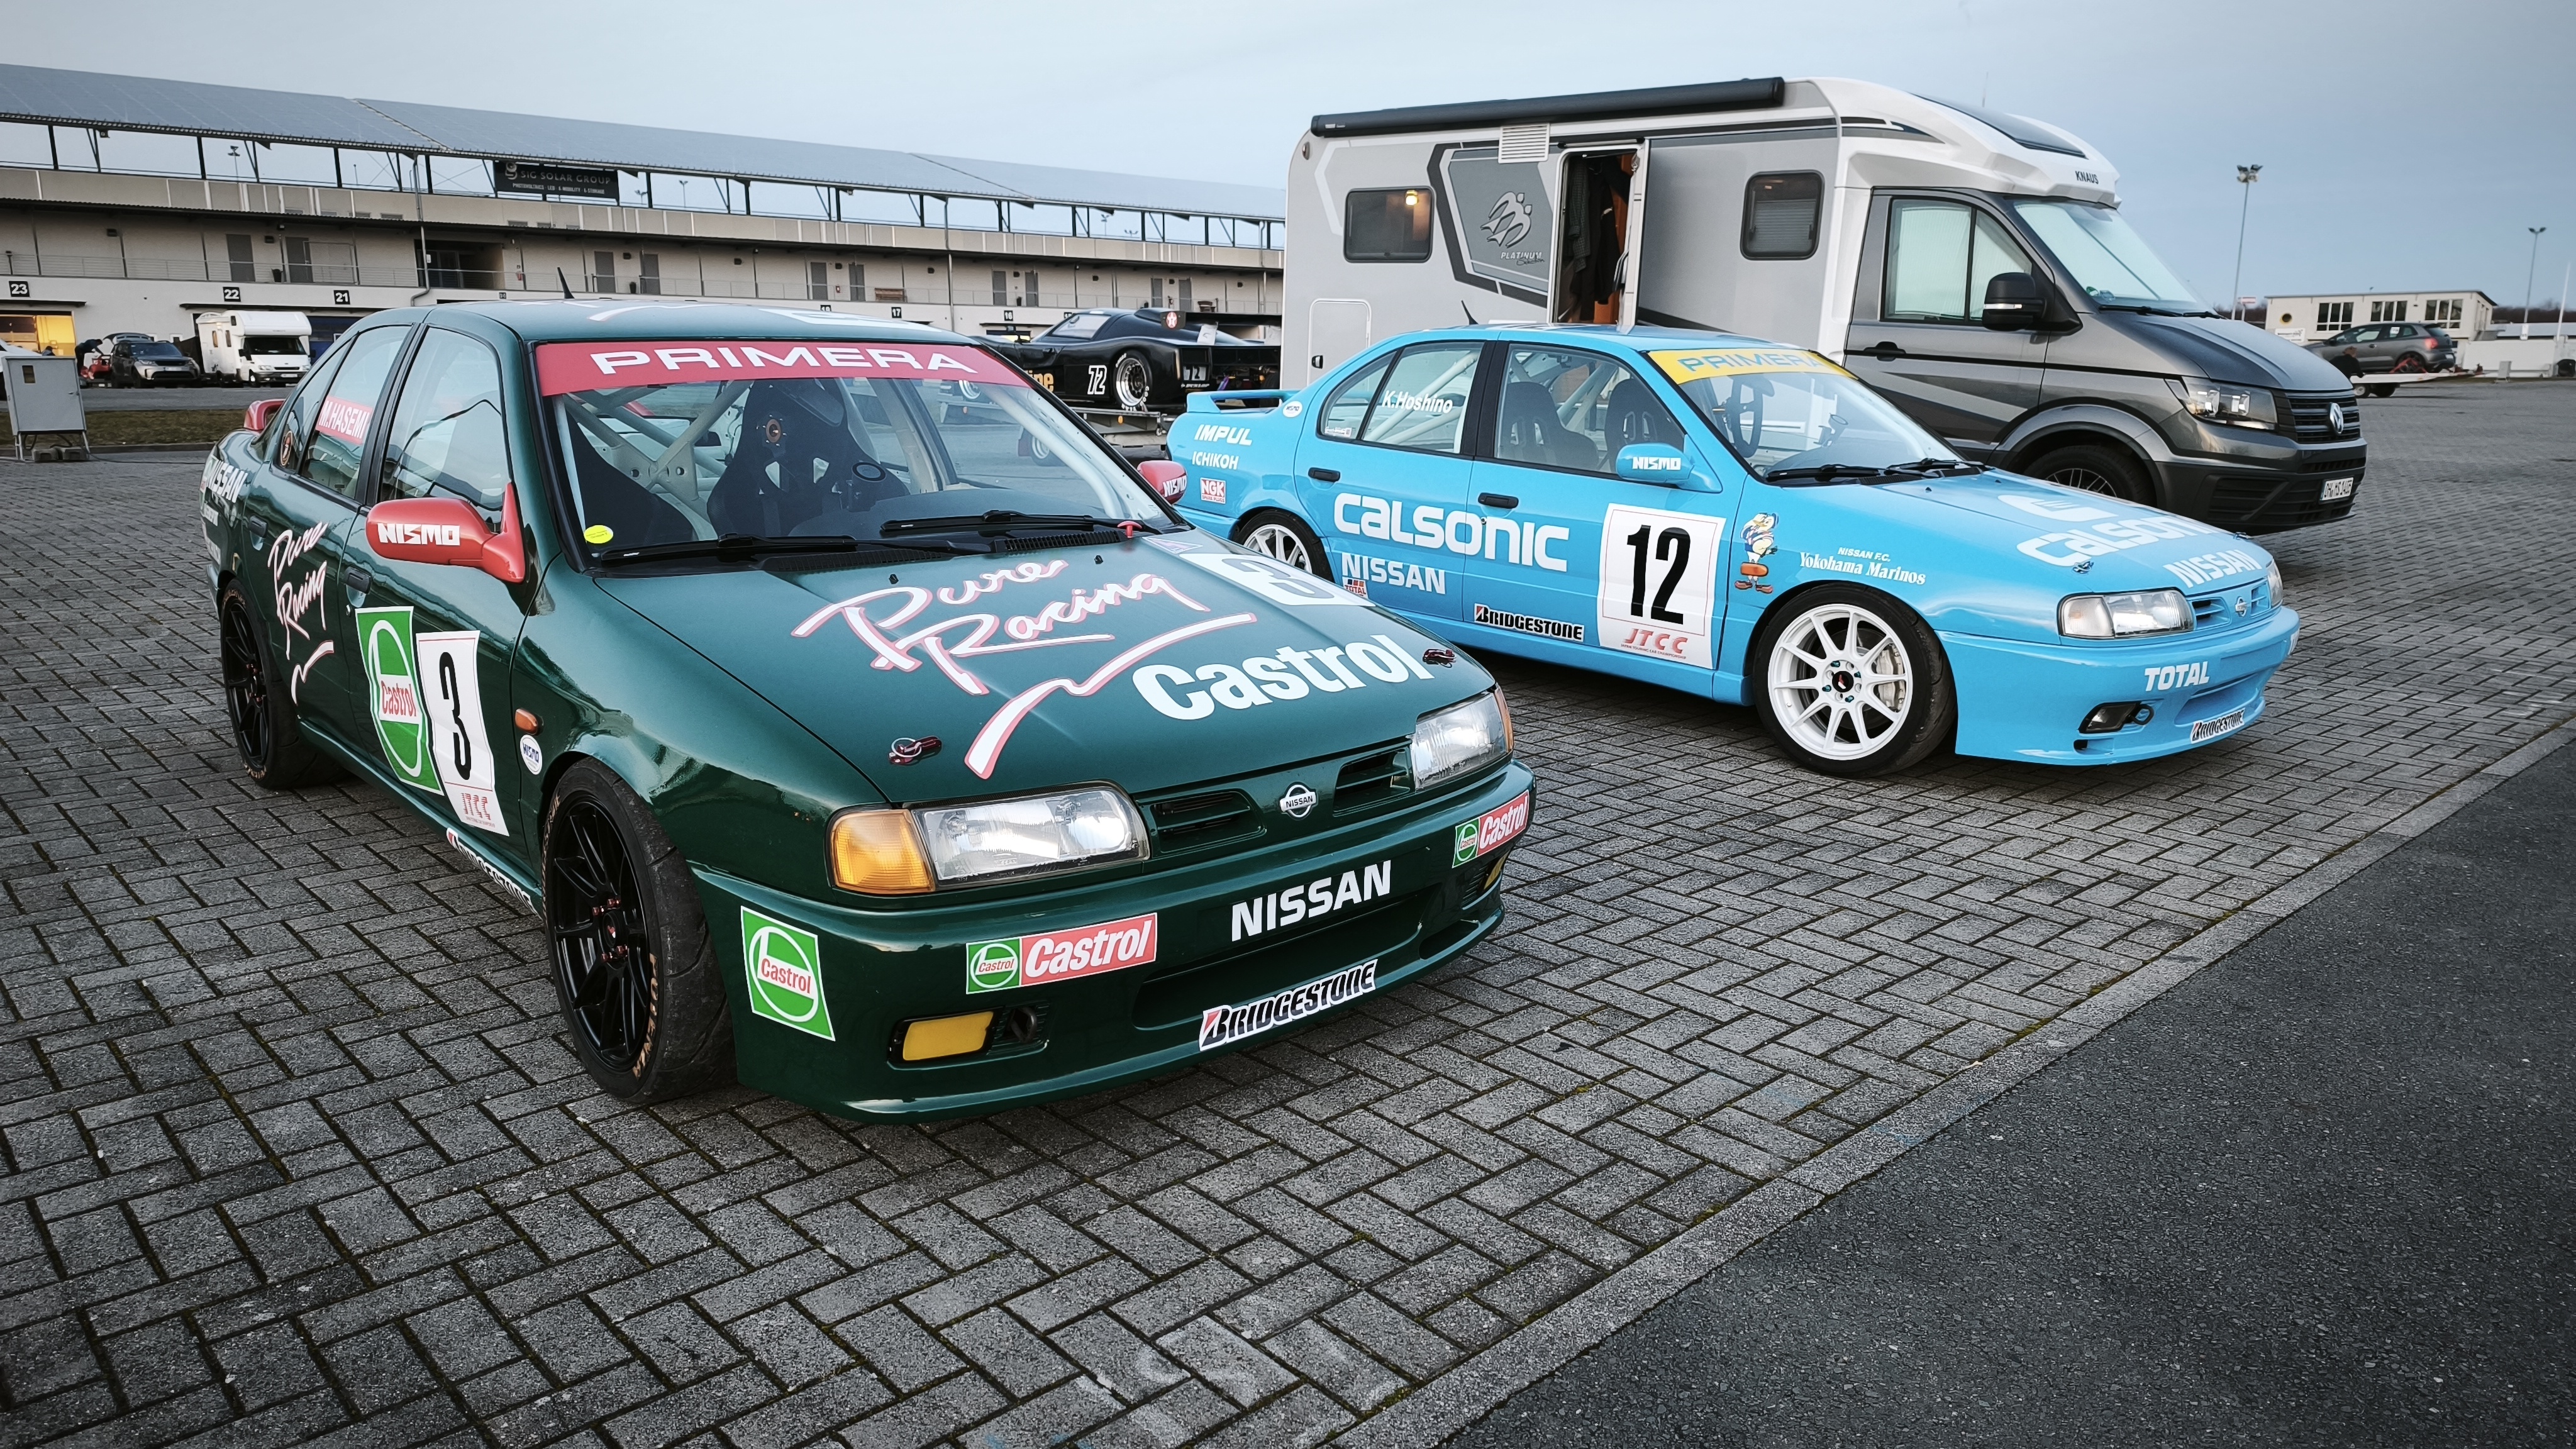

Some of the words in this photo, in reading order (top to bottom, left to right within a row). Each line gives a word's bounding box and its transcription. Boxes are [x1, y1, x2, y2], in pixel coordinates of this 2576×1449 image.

[541, 172, 572, 182] SOLAR
[576, 175, 611, 184] GROUP
[2075, 170, 2099, 184] KNAUS
[1501, 252, 1542, 260] PLATINUM
[11, 284, 28, 294] 23
[224, 289, 239, 299] 22
[335, 292, 348, 302] 21
[892, 308, 900, 317] 17
[591, 347, 977, 375] PRIMERA
[1677, 353, 1823, 372] PRIMERA
[1087, 365, 1107, 395] 72
[1382, 391, 1453, 414] K.Hoshino
[318, 400, 370, 439] M.HASEMI
[1194, 425, 1253, 446] IMPUL
[1192, 451, 1239, 470] ICHIKOH
[1632, 456, 1681, 471] NISMO
[207, 460, 248, 503] NISSAN
[1163, 475, 1187, 497] NISMO
[1201, 479, 1224, 497] NGK
[377, 523, 460, 546] NISMO
[1800, 552, 1863, 575] Yokohama
[1865, 562, 1926, 585] Marinos
[1838, 547, 1873, 559] NISSAN
[2163, 549, 2262, 588] NISSAN
[268, 521, 329, 621] Pure
[1221, 558, 1335, 599] 3
[1341, 553, 1446, 594] NISSAN
[1626, 525, 1691, 625] 12
[277, 560, 327, 660] Racing
[791, 560, 1068, 672] Pure
[1475, 606, 1583, 640] BRIDGESTONE
[870, 571, 1211, 696] Racing
[1624, 628, 1688, 654] JTCC
[1132, 635, 1434, 721] Castrol
[2145, 661, 2211, 692] TOTAL
[381, 679, 417, 717] Castrol
[440, 652, 471, 780] 3
[2191, 710, 2245, 742] BRIDGESTONE
[1285, 794, 1313, 808] NISSAN
[1480, 795, 1528, 849] Castrol
[1232, 860, 1391, 941] NISSAN
[1024, 919, 1152, 979] Castrol
[761, 957, 811, 994] Castrol
[979, 957, 1014, 974] Castrol
[1201, 962, 1375, 1048] BRIDGESTONE
